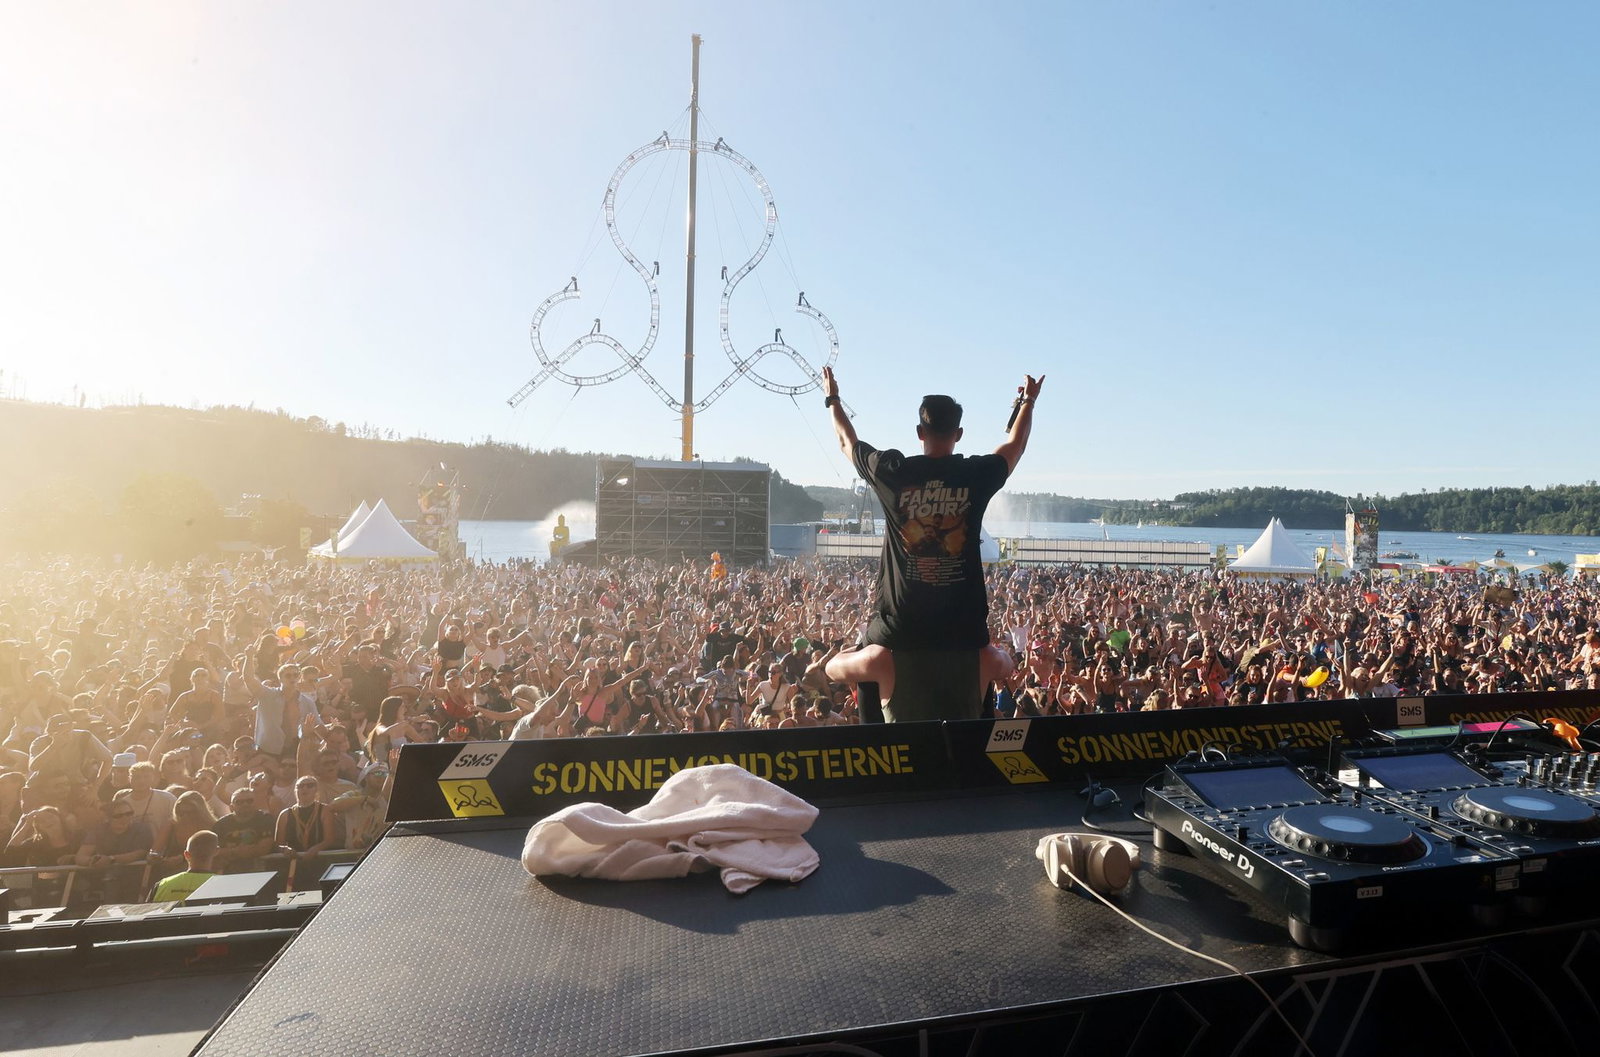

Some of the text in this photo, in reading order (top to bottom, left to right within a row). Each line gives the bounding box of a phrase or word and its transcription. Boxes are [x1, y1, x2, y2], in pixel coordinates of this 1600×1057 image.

[907, 501, 957, 520] TOUR
[1400, 706, 1422, 717] SMS
[993, 728, 1024, 742] SMS
[455, 753, 498, 768] SMS
[1181, 820, 1255, 879] Pioneer DJ
